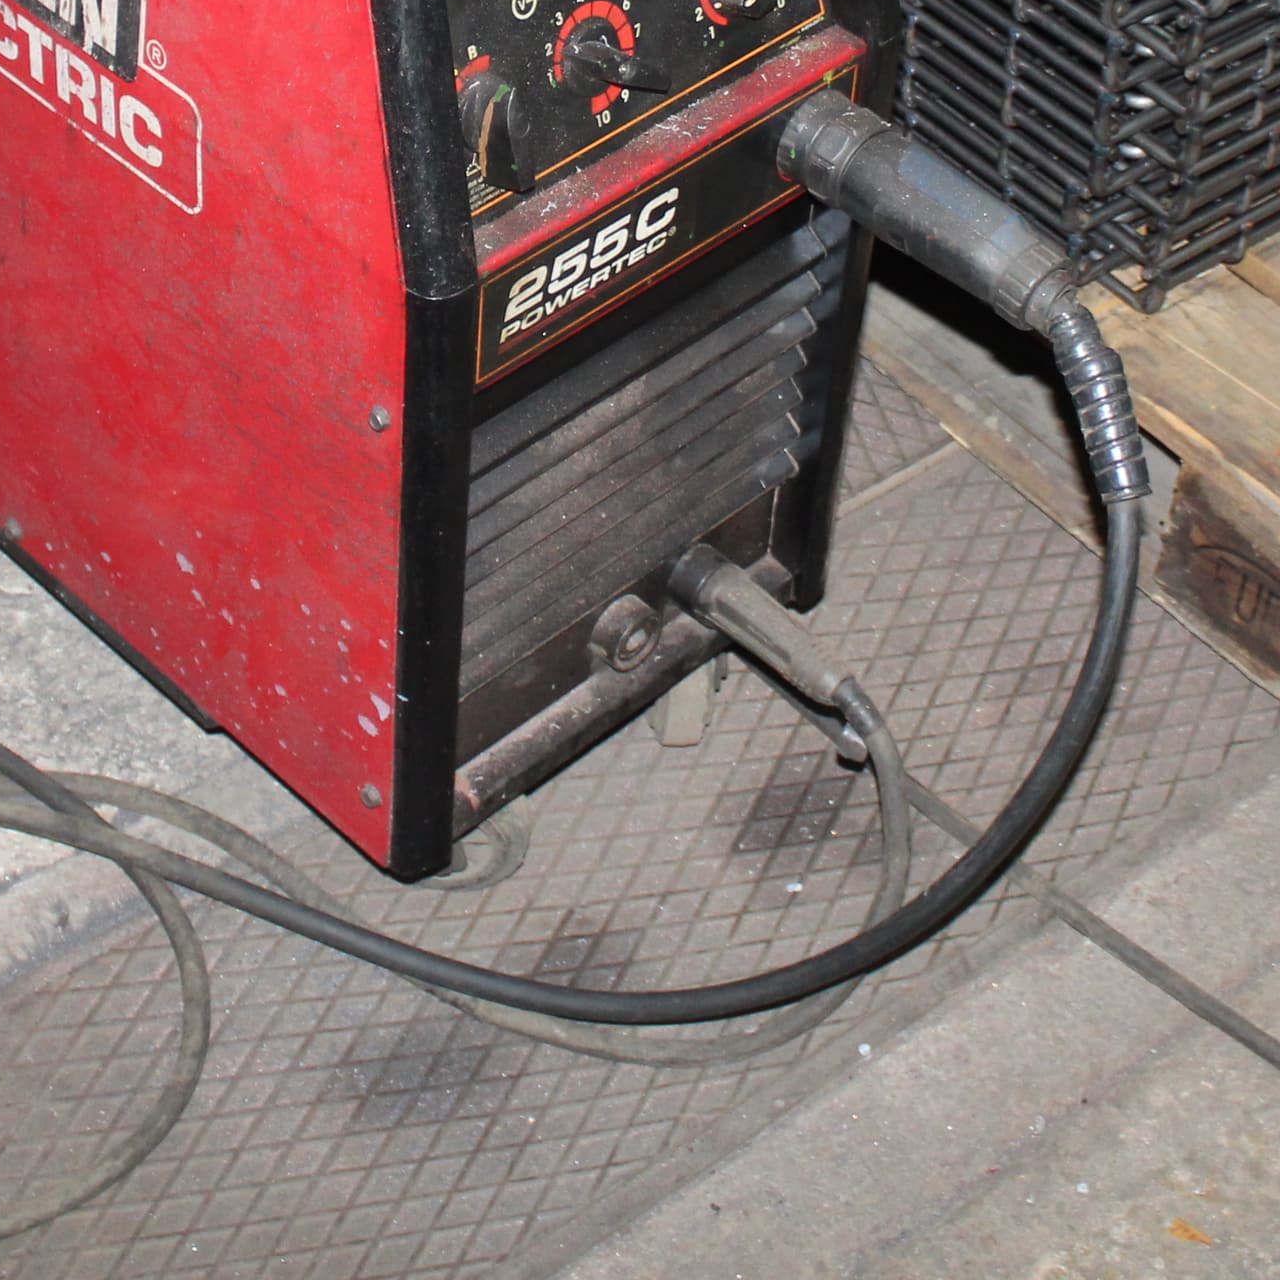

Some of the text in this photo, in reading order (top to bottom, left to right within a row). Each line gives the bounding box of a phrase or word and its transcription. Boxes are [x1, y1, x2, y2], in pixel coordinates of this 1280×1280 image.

[554, 11, 564, 26] 3
[695, 7, 704, 22] 2
[633, 23, 641, 38] 7
[708, 26, 716, 39] 1
[467, 45, 478, 60] B
[544, 42, 553, 57] 2
[620, 89, 630, 103] 9
[595, 110, 611, 128] 10
[504, 187, 680, 323] 255C
